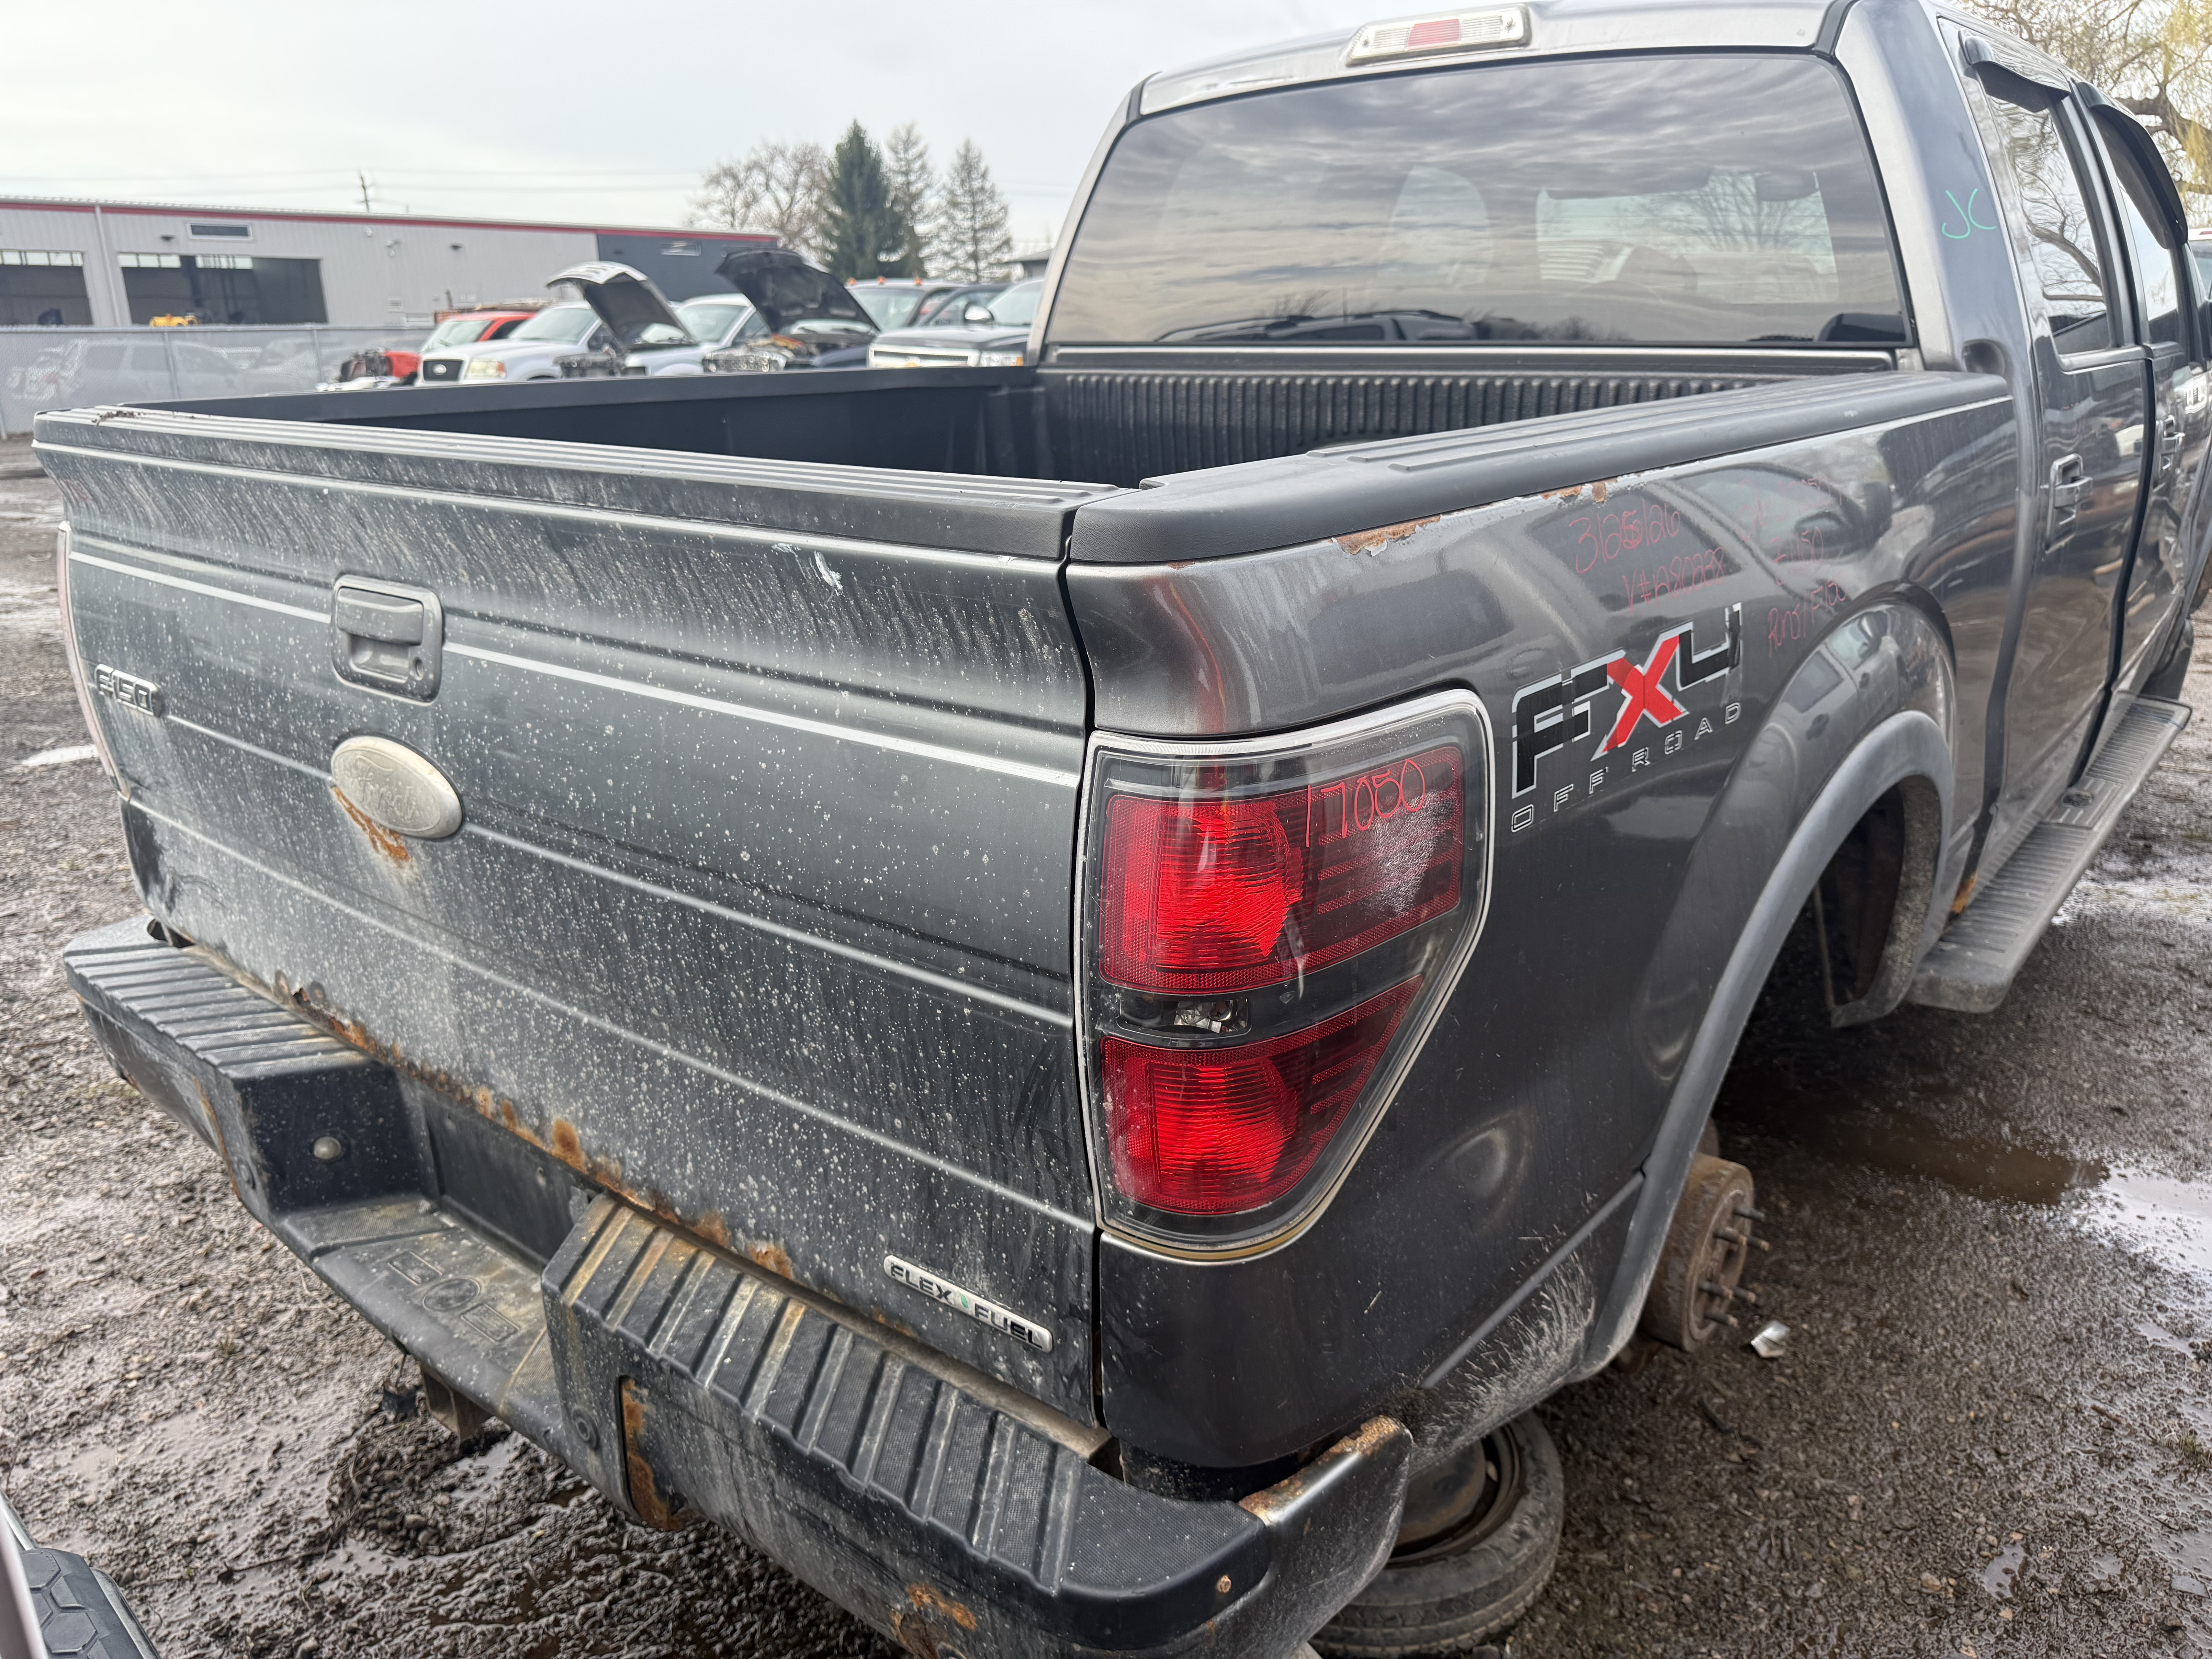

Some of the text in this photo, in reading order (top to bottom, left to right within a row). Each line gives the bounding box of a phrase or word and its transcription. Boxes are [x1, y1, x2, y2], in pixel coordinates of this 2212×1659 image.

[1941, 188, 1996, 239] JC
[1511, 602, 1742, 799] FX4
[1305, 758, 1426, 847] 17050
[890, 1262, 1042, 1349] FLEX FUEL
